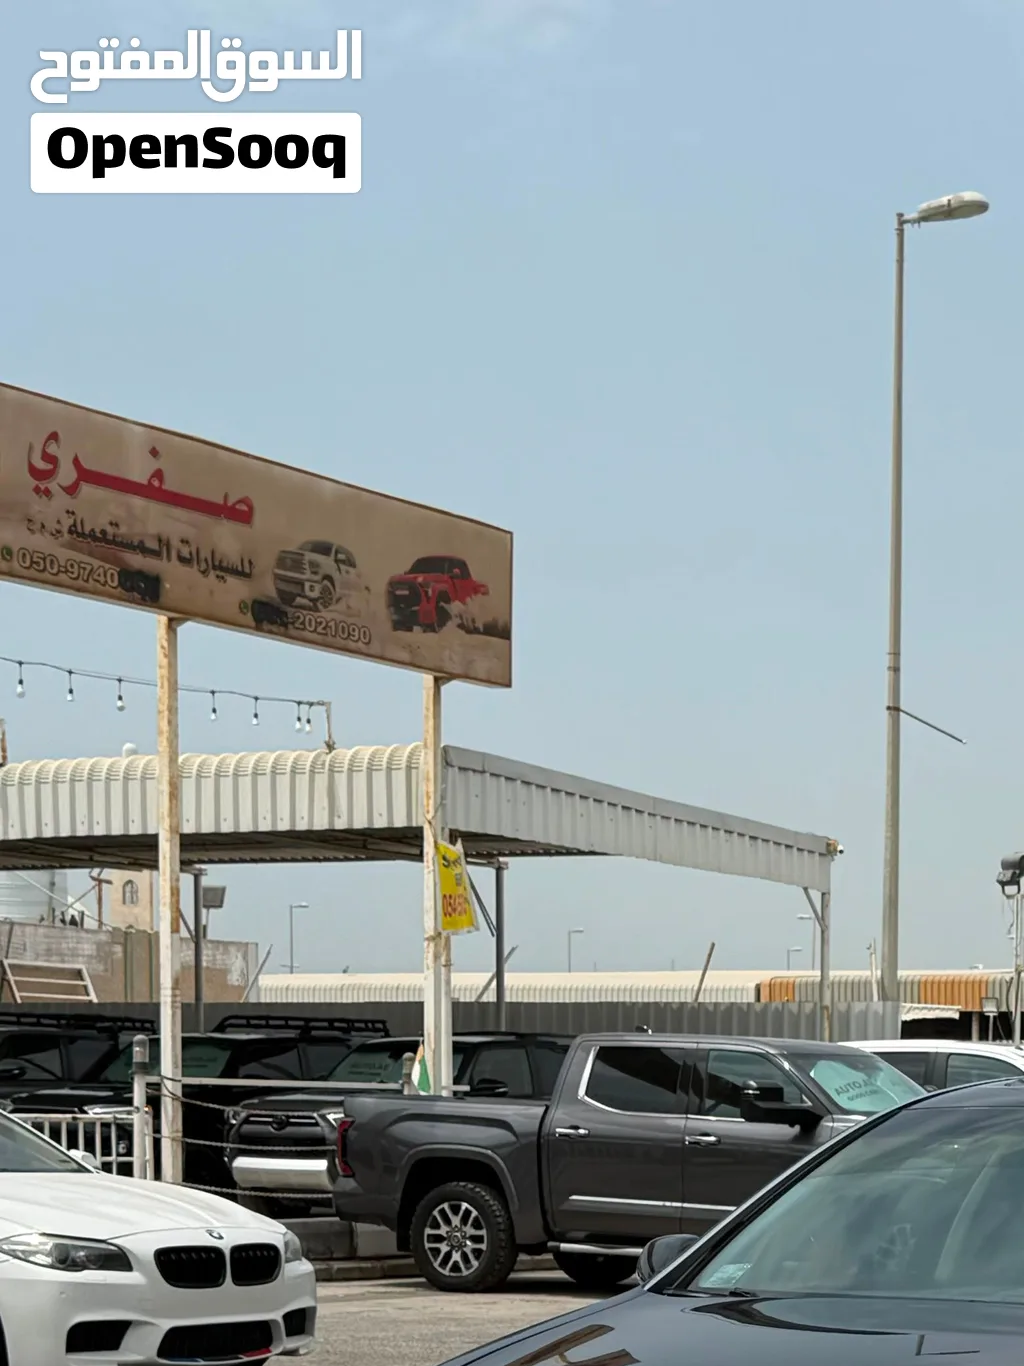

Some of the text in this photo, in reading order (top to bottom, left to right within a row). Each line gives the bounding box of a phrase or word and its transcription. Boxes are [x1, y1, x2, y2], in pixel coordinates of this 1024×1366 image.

[27, 430, 254, 525] صفري
[65, 508, 172, 562] المستعملة
[176, 535, 255, 583] للسيارات
[17, 547, 159, 602] 050-9740
